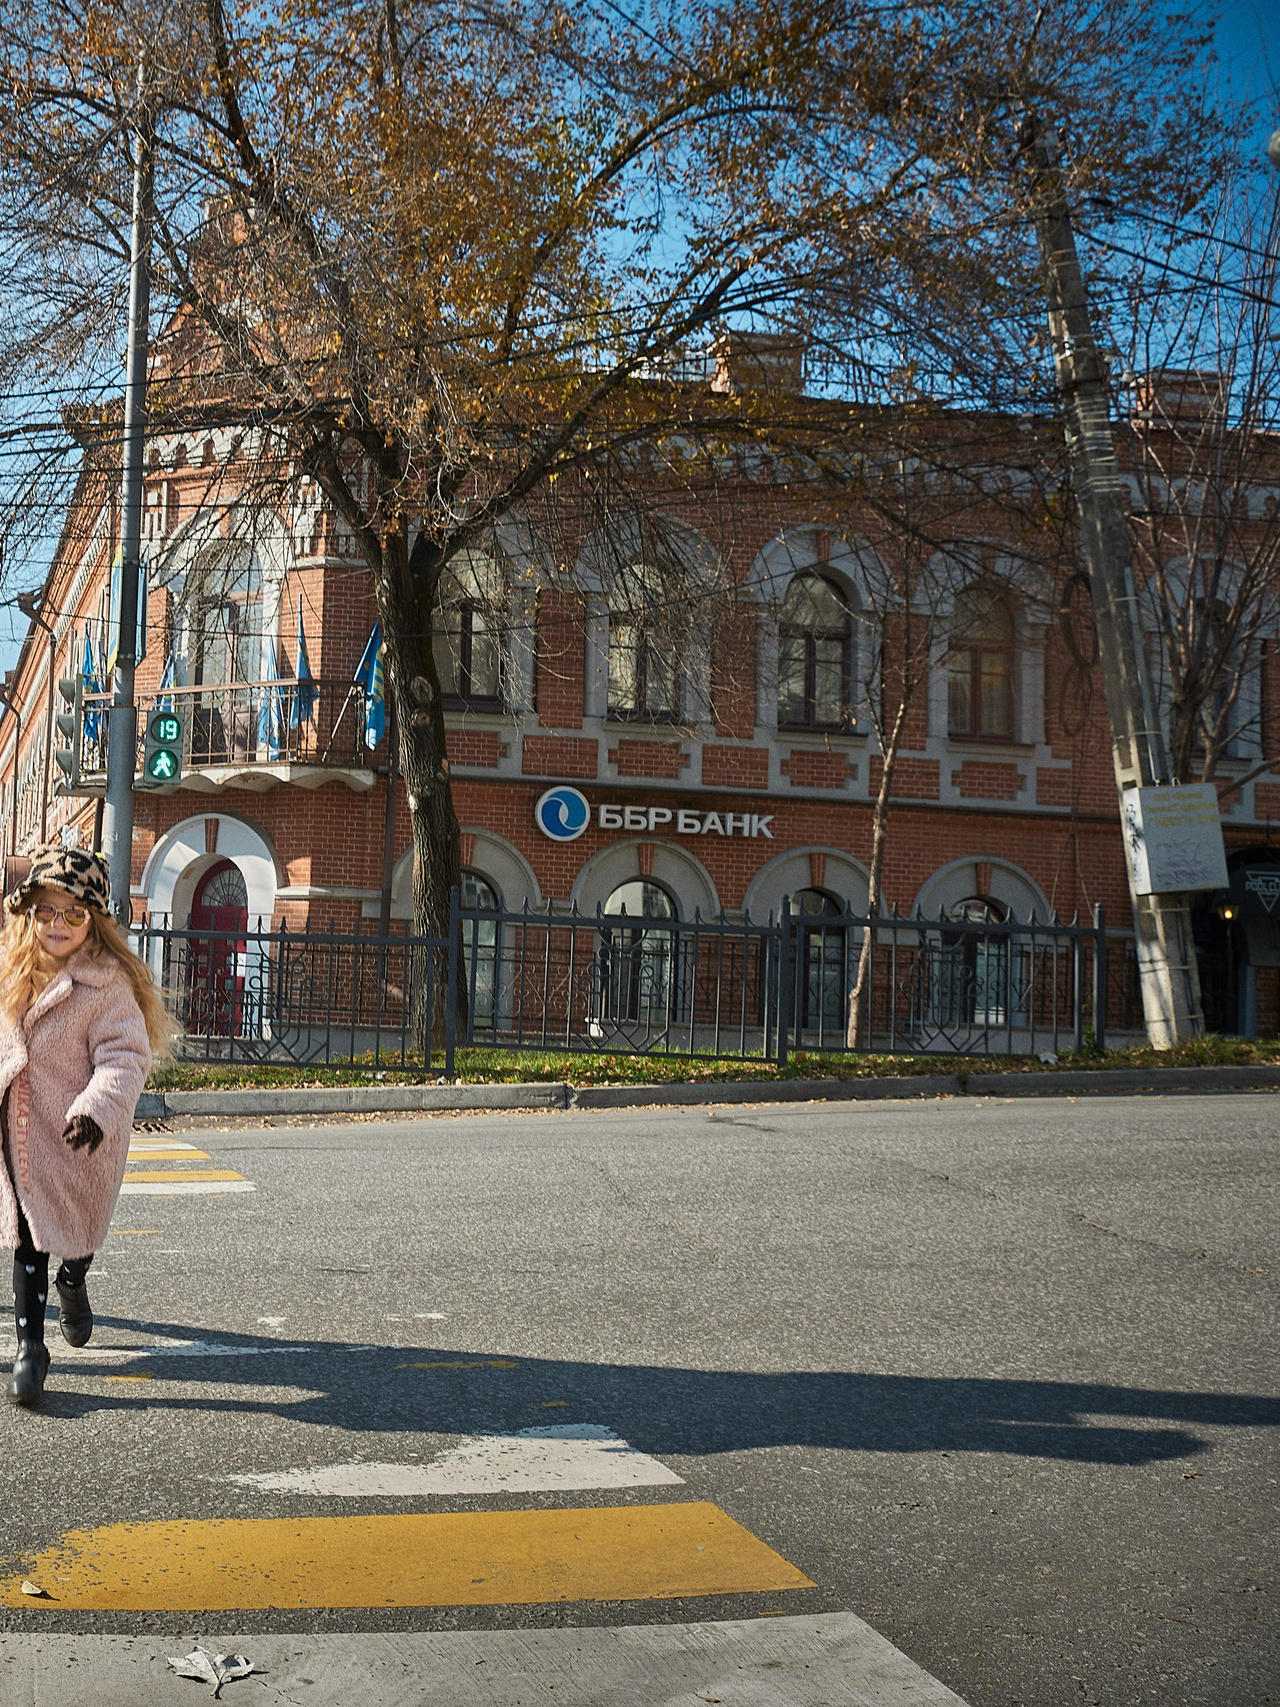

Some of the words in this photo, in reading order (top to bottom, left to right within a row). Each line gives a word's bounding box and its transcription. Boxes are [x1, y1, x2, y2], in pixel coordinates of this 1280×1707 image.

[160, 720, 178, 740] 19
[598, 804, 672, 831] ББР
[676, 809, 774, 839] БАНК
[1245, 881, 1268, 891] POOL
